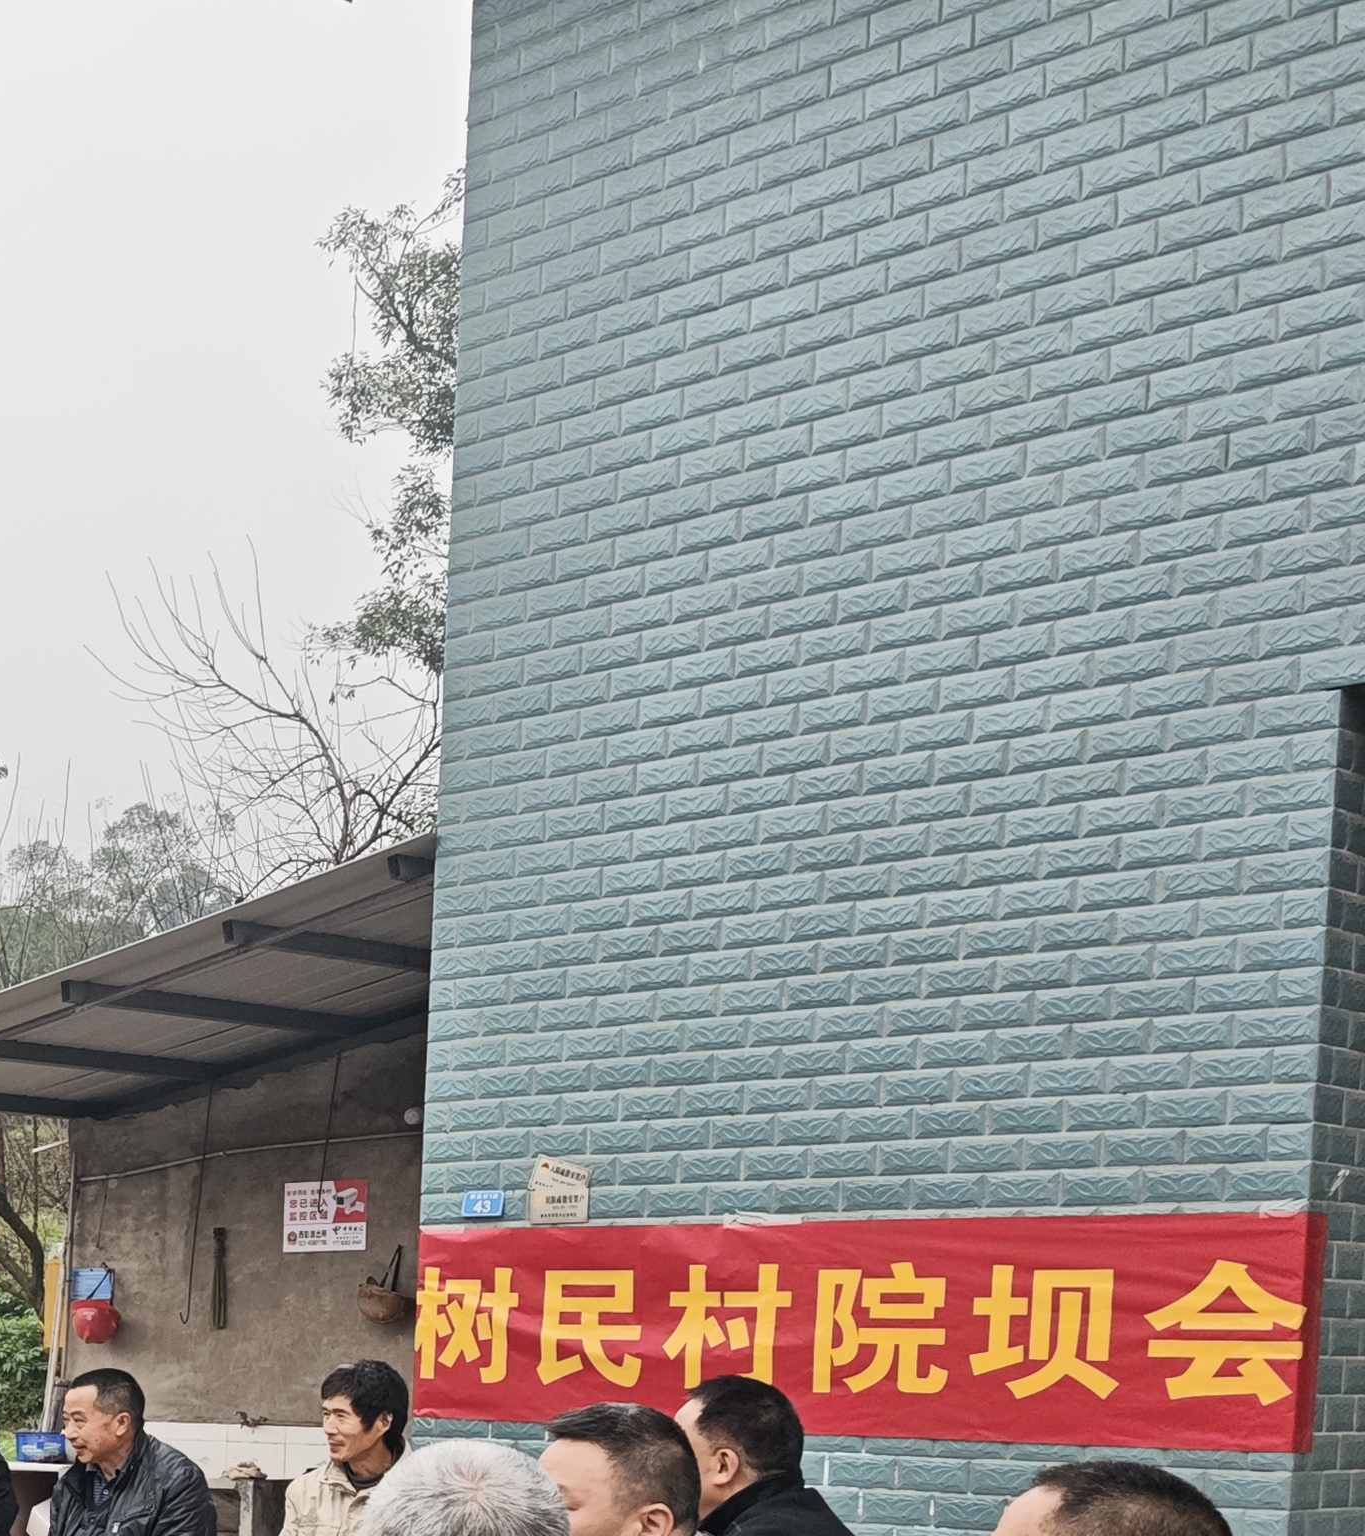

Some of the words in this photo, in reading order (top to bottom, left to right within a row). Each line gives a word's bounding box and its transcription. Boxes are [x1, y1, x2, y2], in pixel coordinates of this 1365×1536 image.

[289, 1198, 329, 1209] 您已进入
[473, 1199, 492, 1213] 43
[289, 1211, 329, 1222] 监控区域
[413, 1260, 1309, 1407] 树民村院坝会
